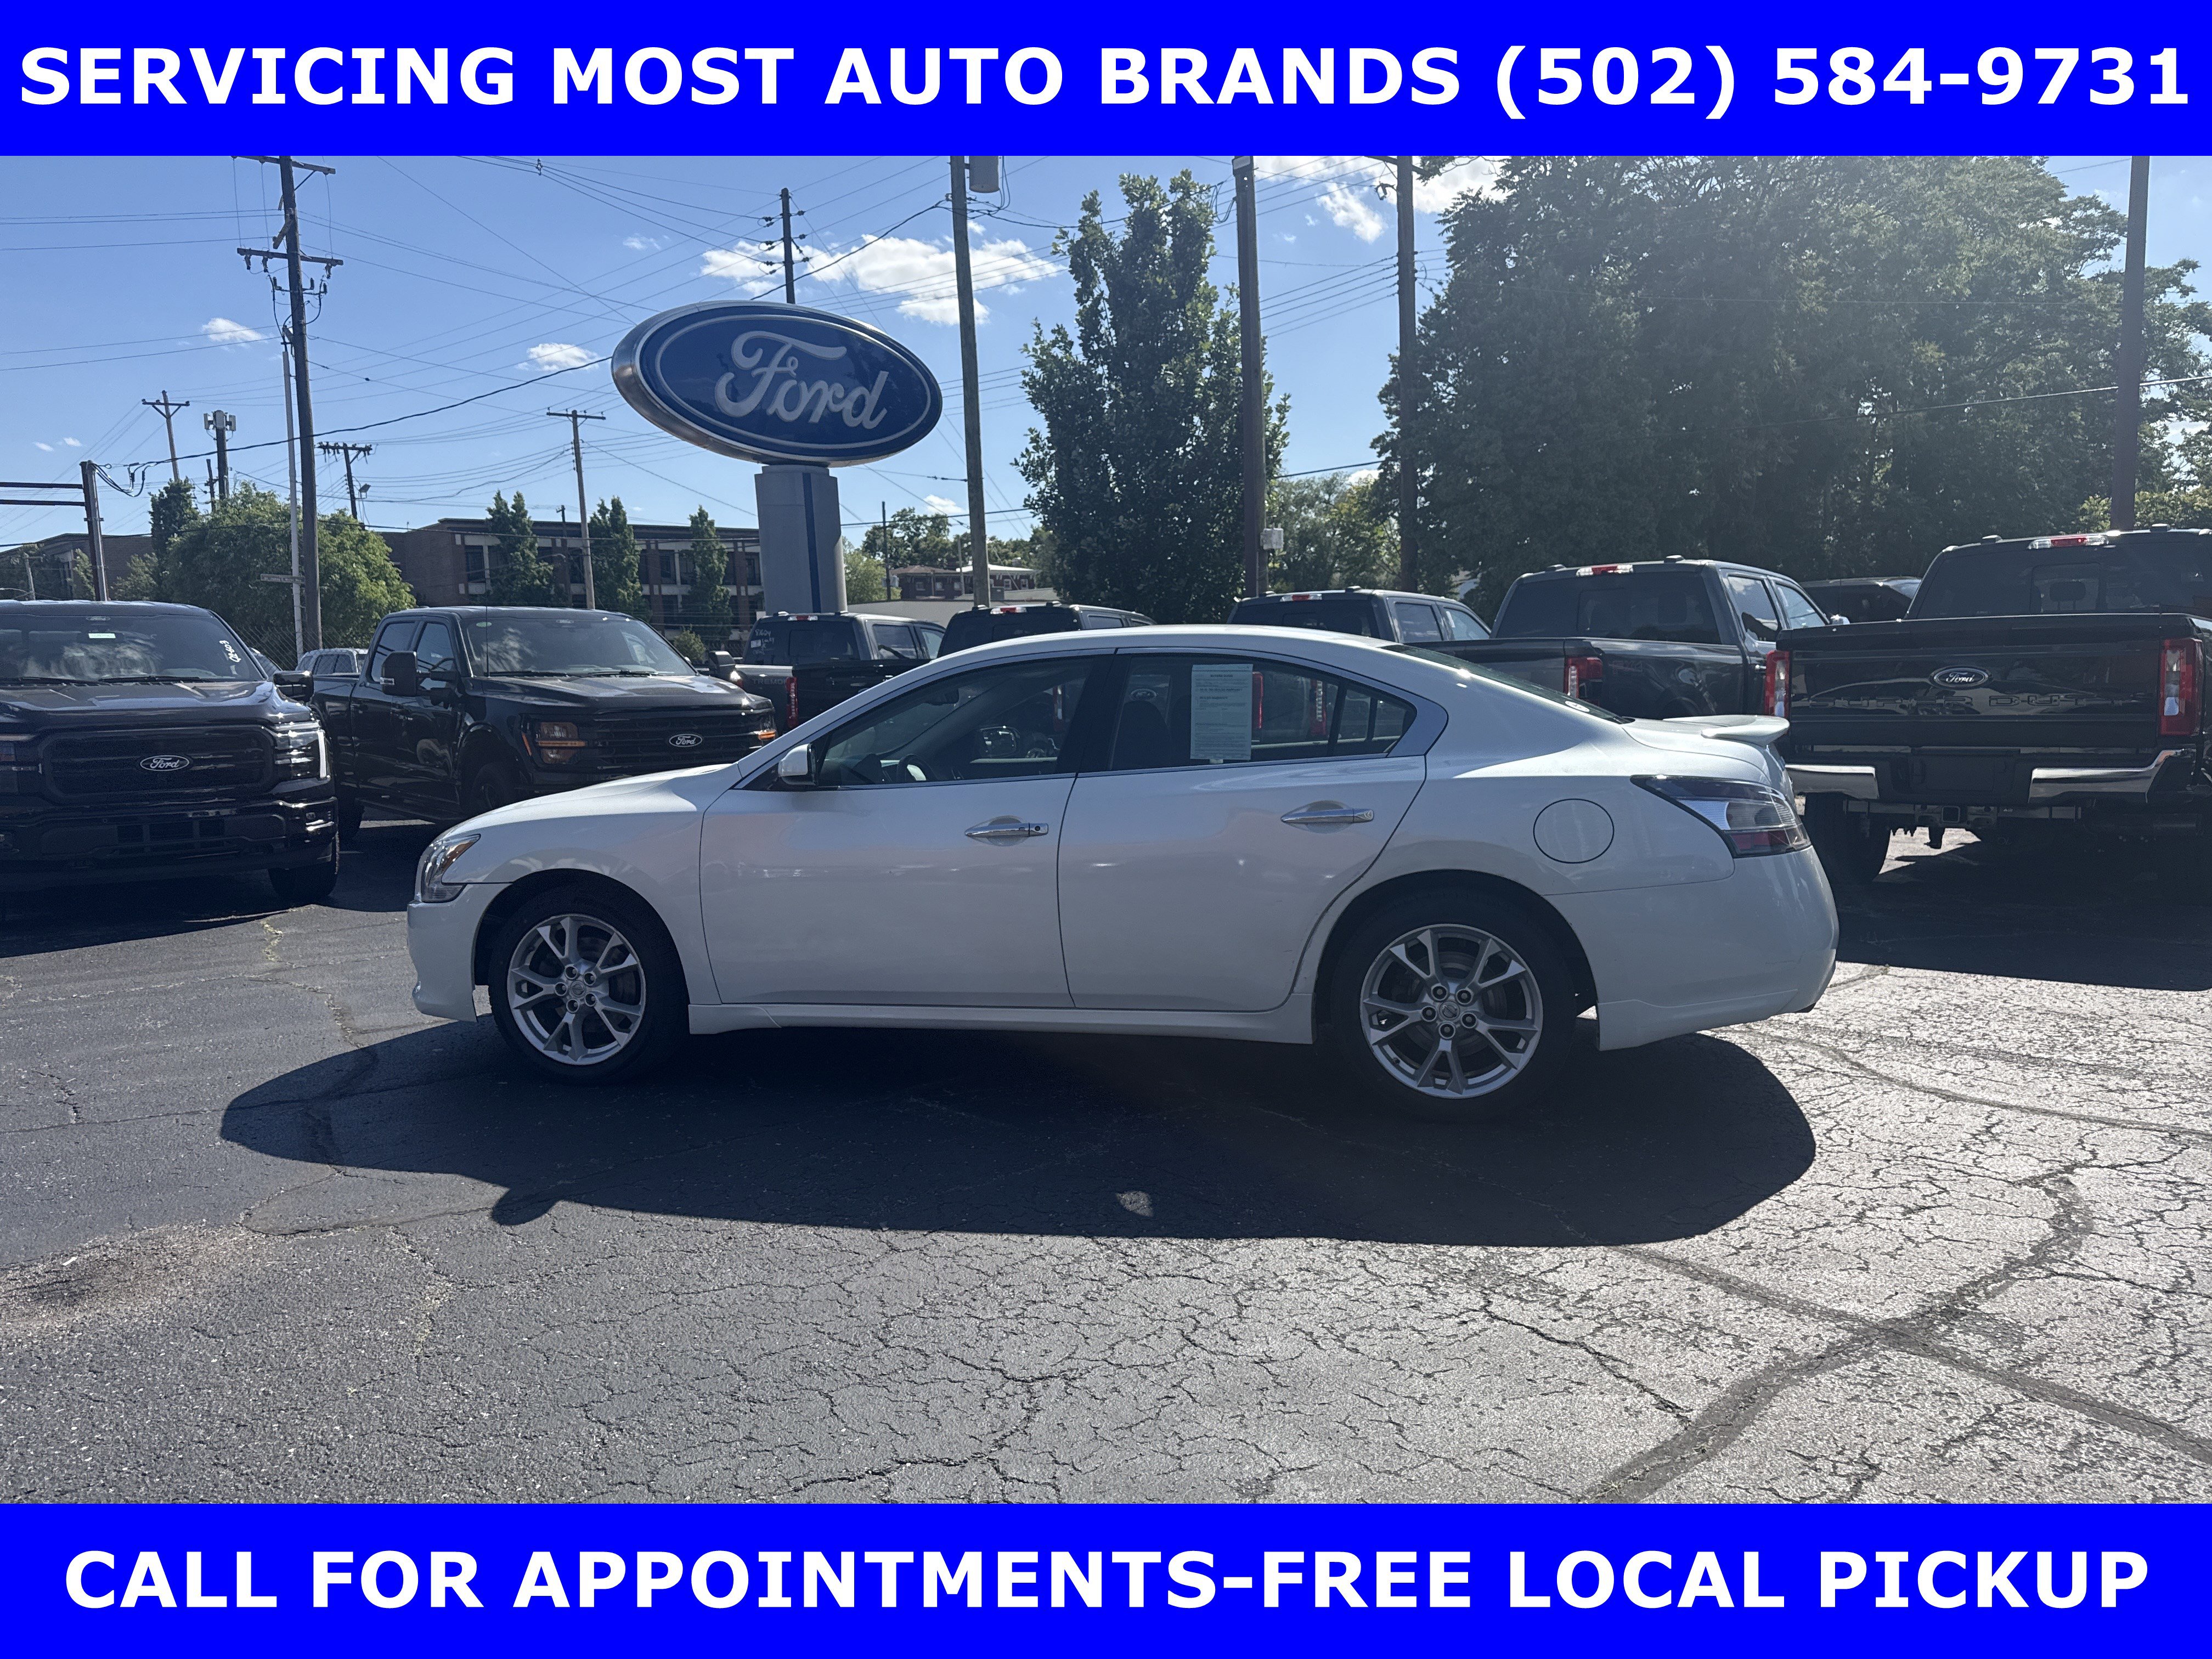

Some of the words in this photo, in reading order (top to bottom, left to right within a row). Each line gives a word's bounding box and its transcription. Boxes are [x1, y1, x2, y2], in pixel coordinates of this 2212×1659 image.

[715, 330, 889, 430] Ford
[1945, 671, 1975, 683] Ford
[675, 736, 696, 745] Ford
[150, 757, 179, 769] Ford
